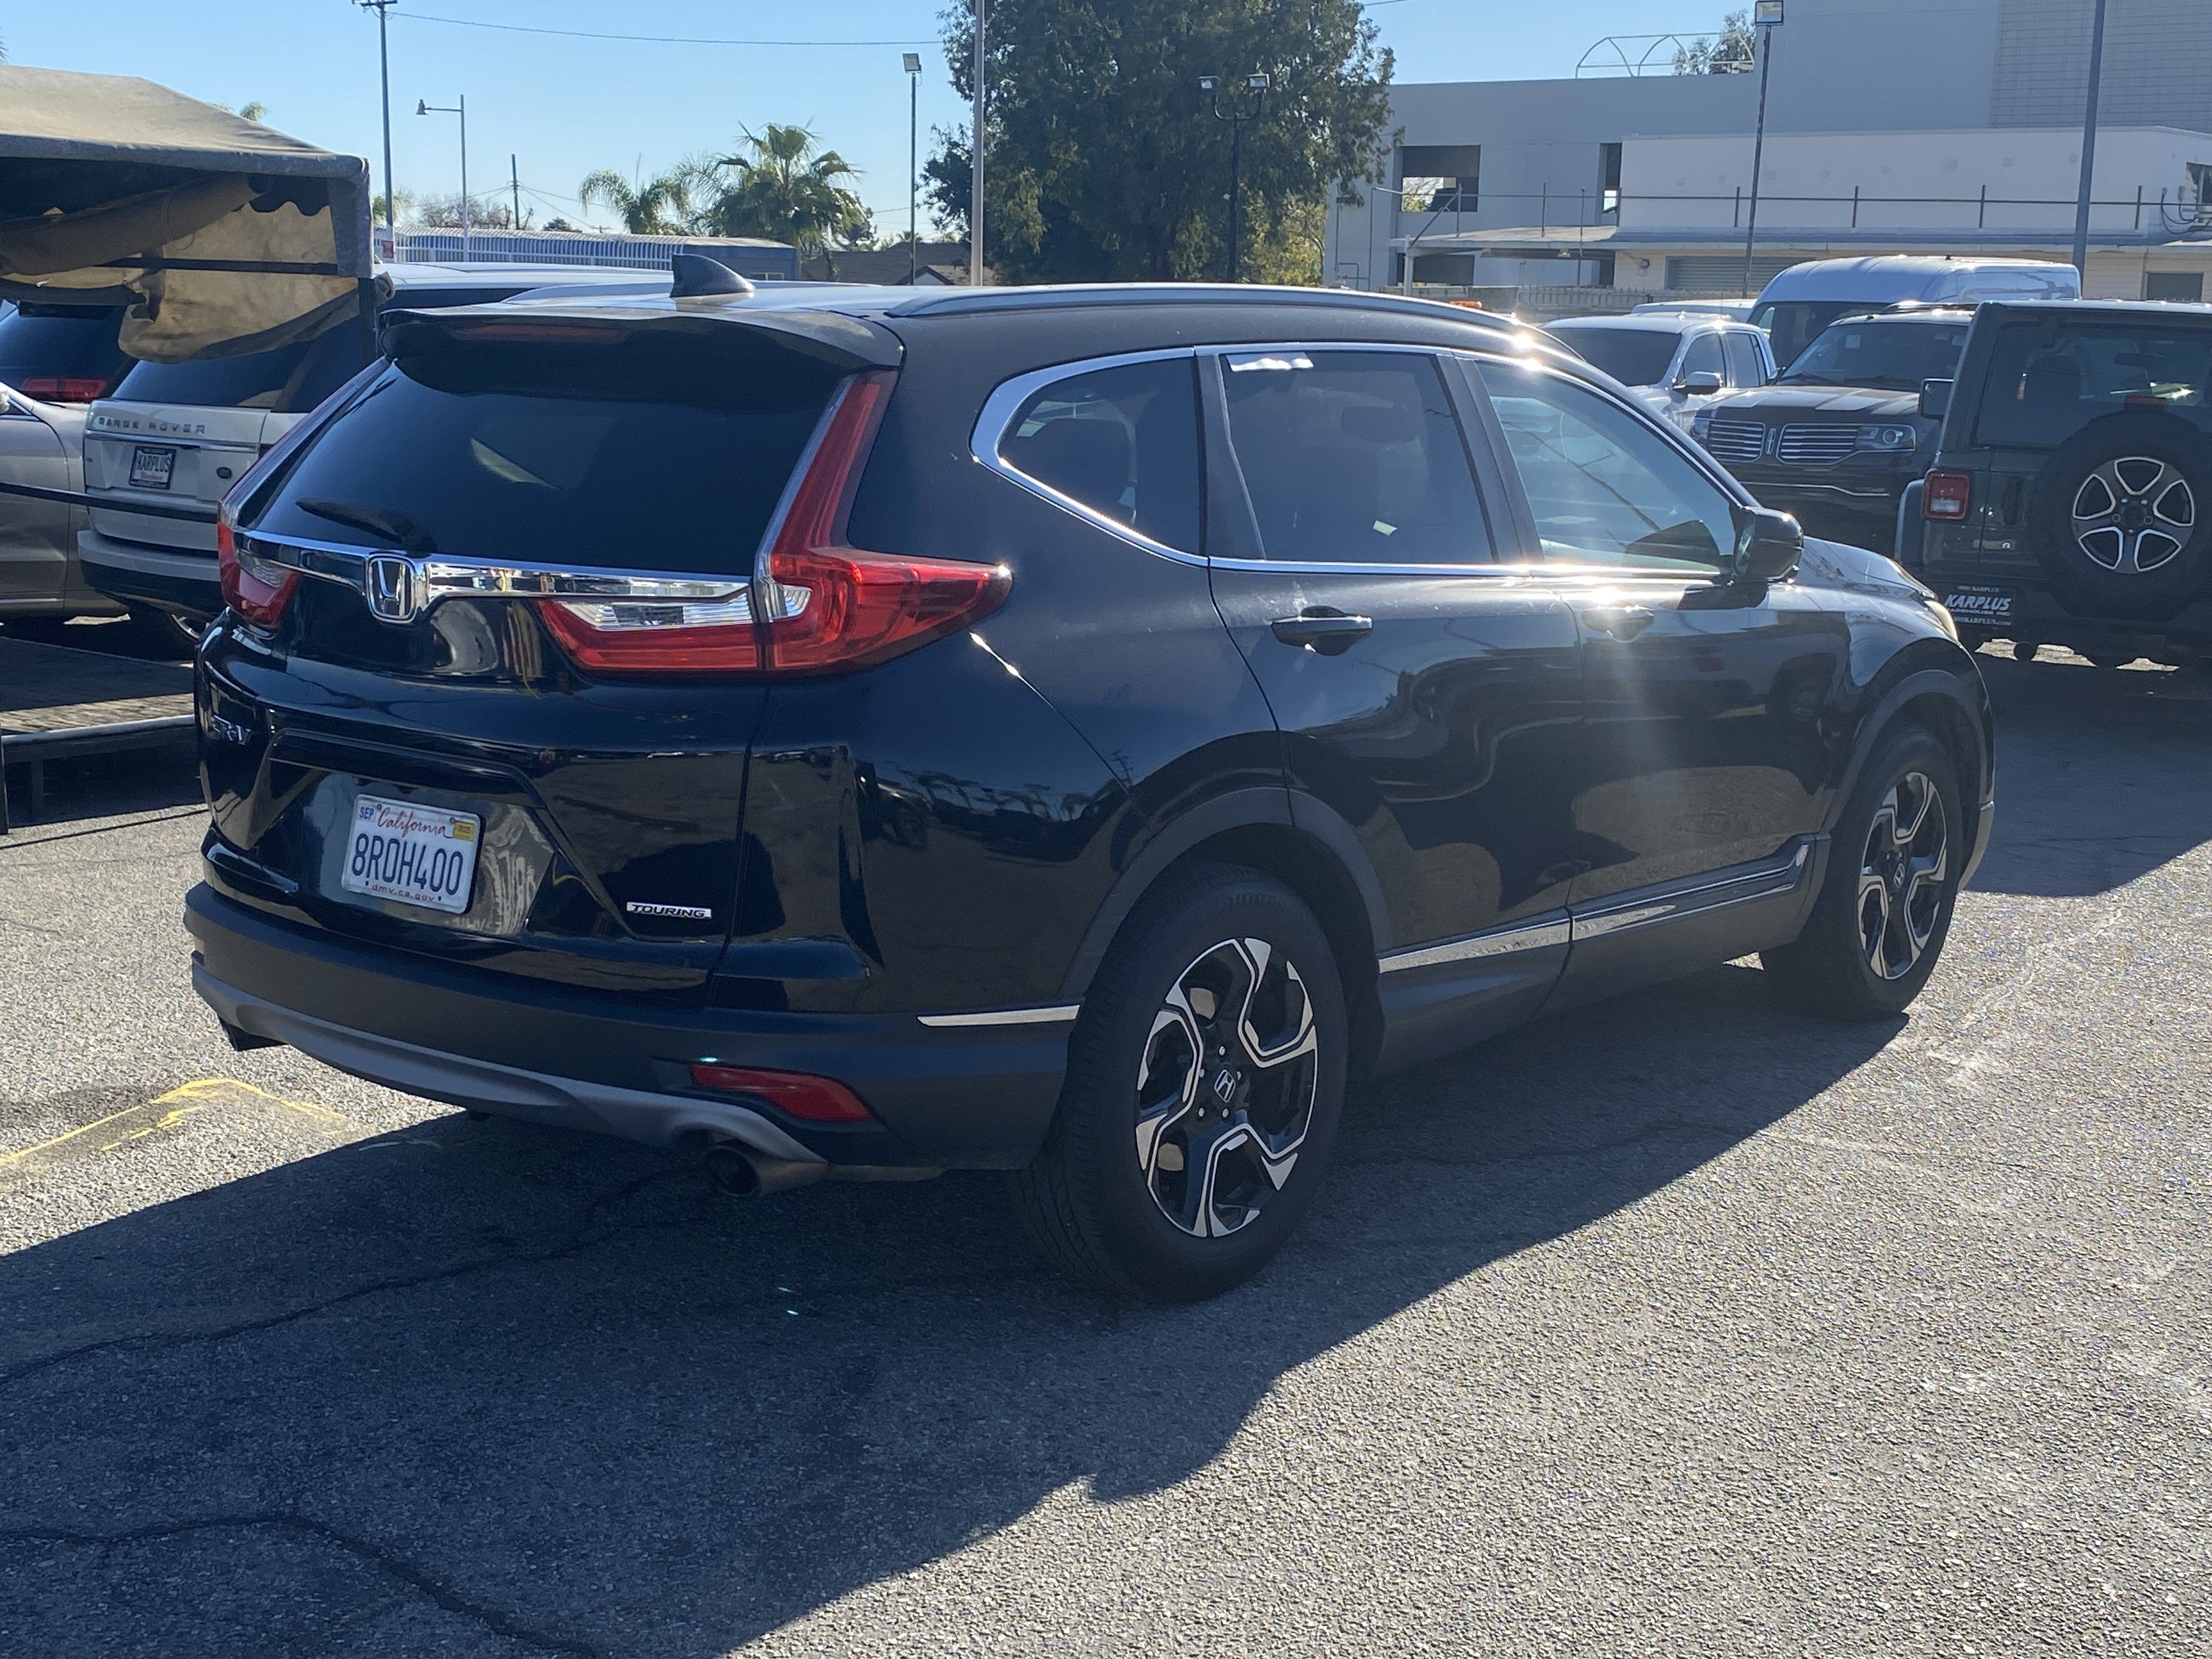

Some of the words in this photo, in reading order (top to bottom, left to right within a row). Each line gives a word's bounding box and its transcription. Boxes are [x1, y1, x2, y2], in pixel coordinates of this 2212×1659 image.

[99, 417, 139, 429] RANGE
[149, 421, 205, 434] ROVER
[137, 453, 171, 473] KARPLUS
[1944, 594, 2012, 611] KARPLUS
[359, 806, 375, 820] SEP
[377, 807, 453, 838] California
[352, 833, 464, 895] 8ROH400
[372, 884, 435, 901] dmv.ca.gov
[631, 904, 706, 918] TOURING
